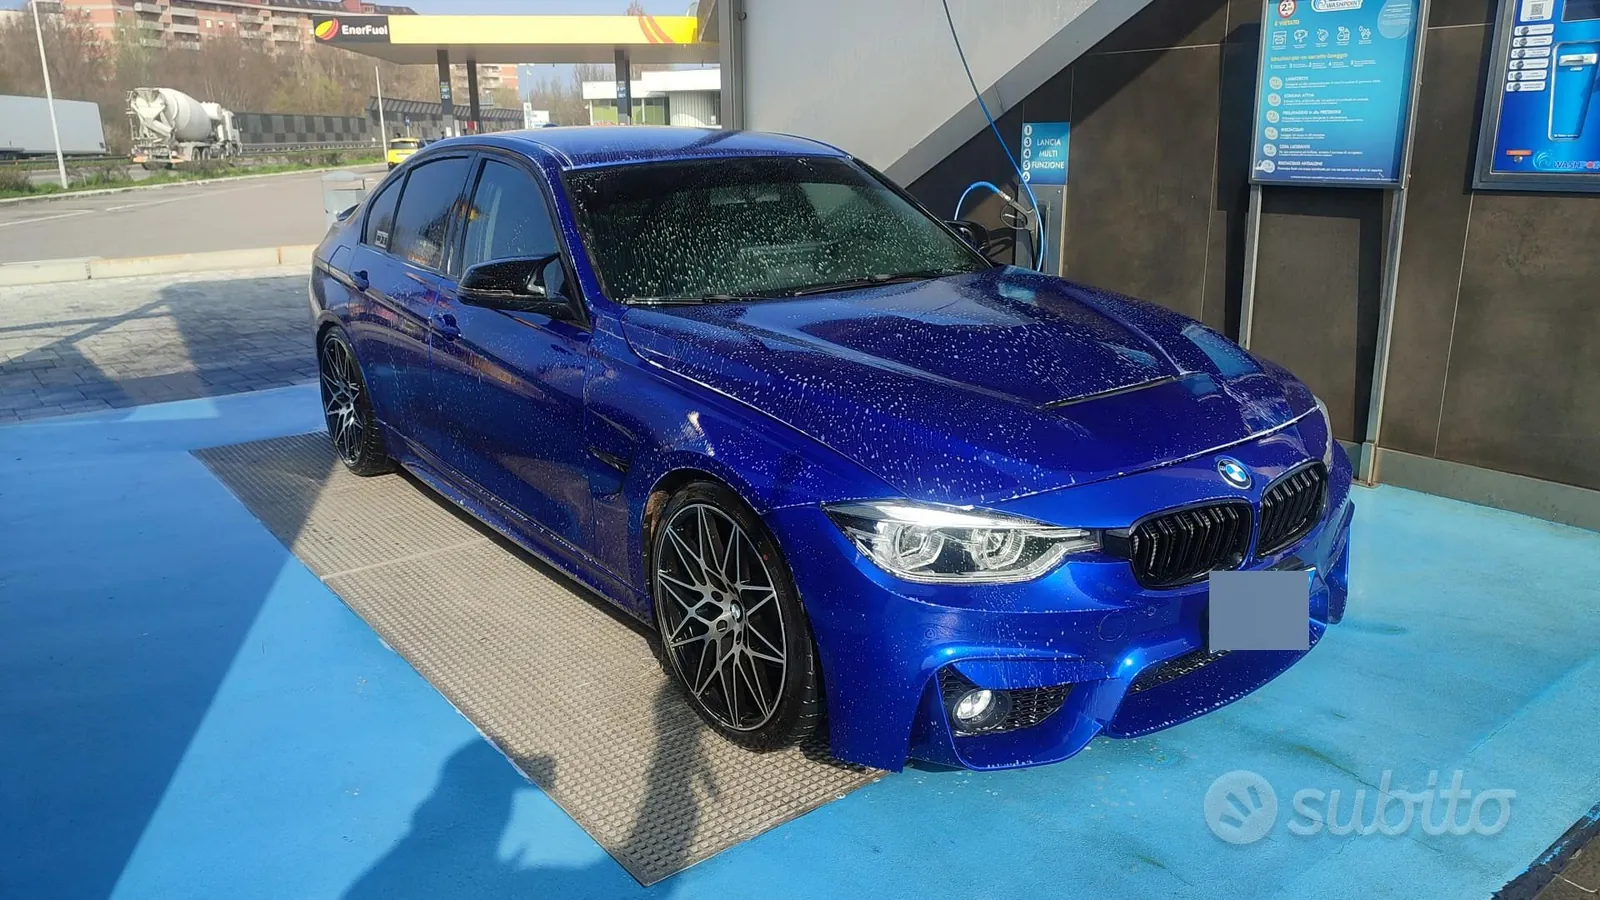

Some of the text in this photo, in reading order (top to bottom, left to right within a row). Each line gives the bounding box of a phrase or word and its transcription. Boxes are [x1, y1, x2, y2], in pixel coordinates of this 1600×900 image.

[341, 25, 388, 35] EnerFuel
[1037, 138, 1061, 146] LANCIA
[1031, 161, 1064, 169] FUNZIONE
